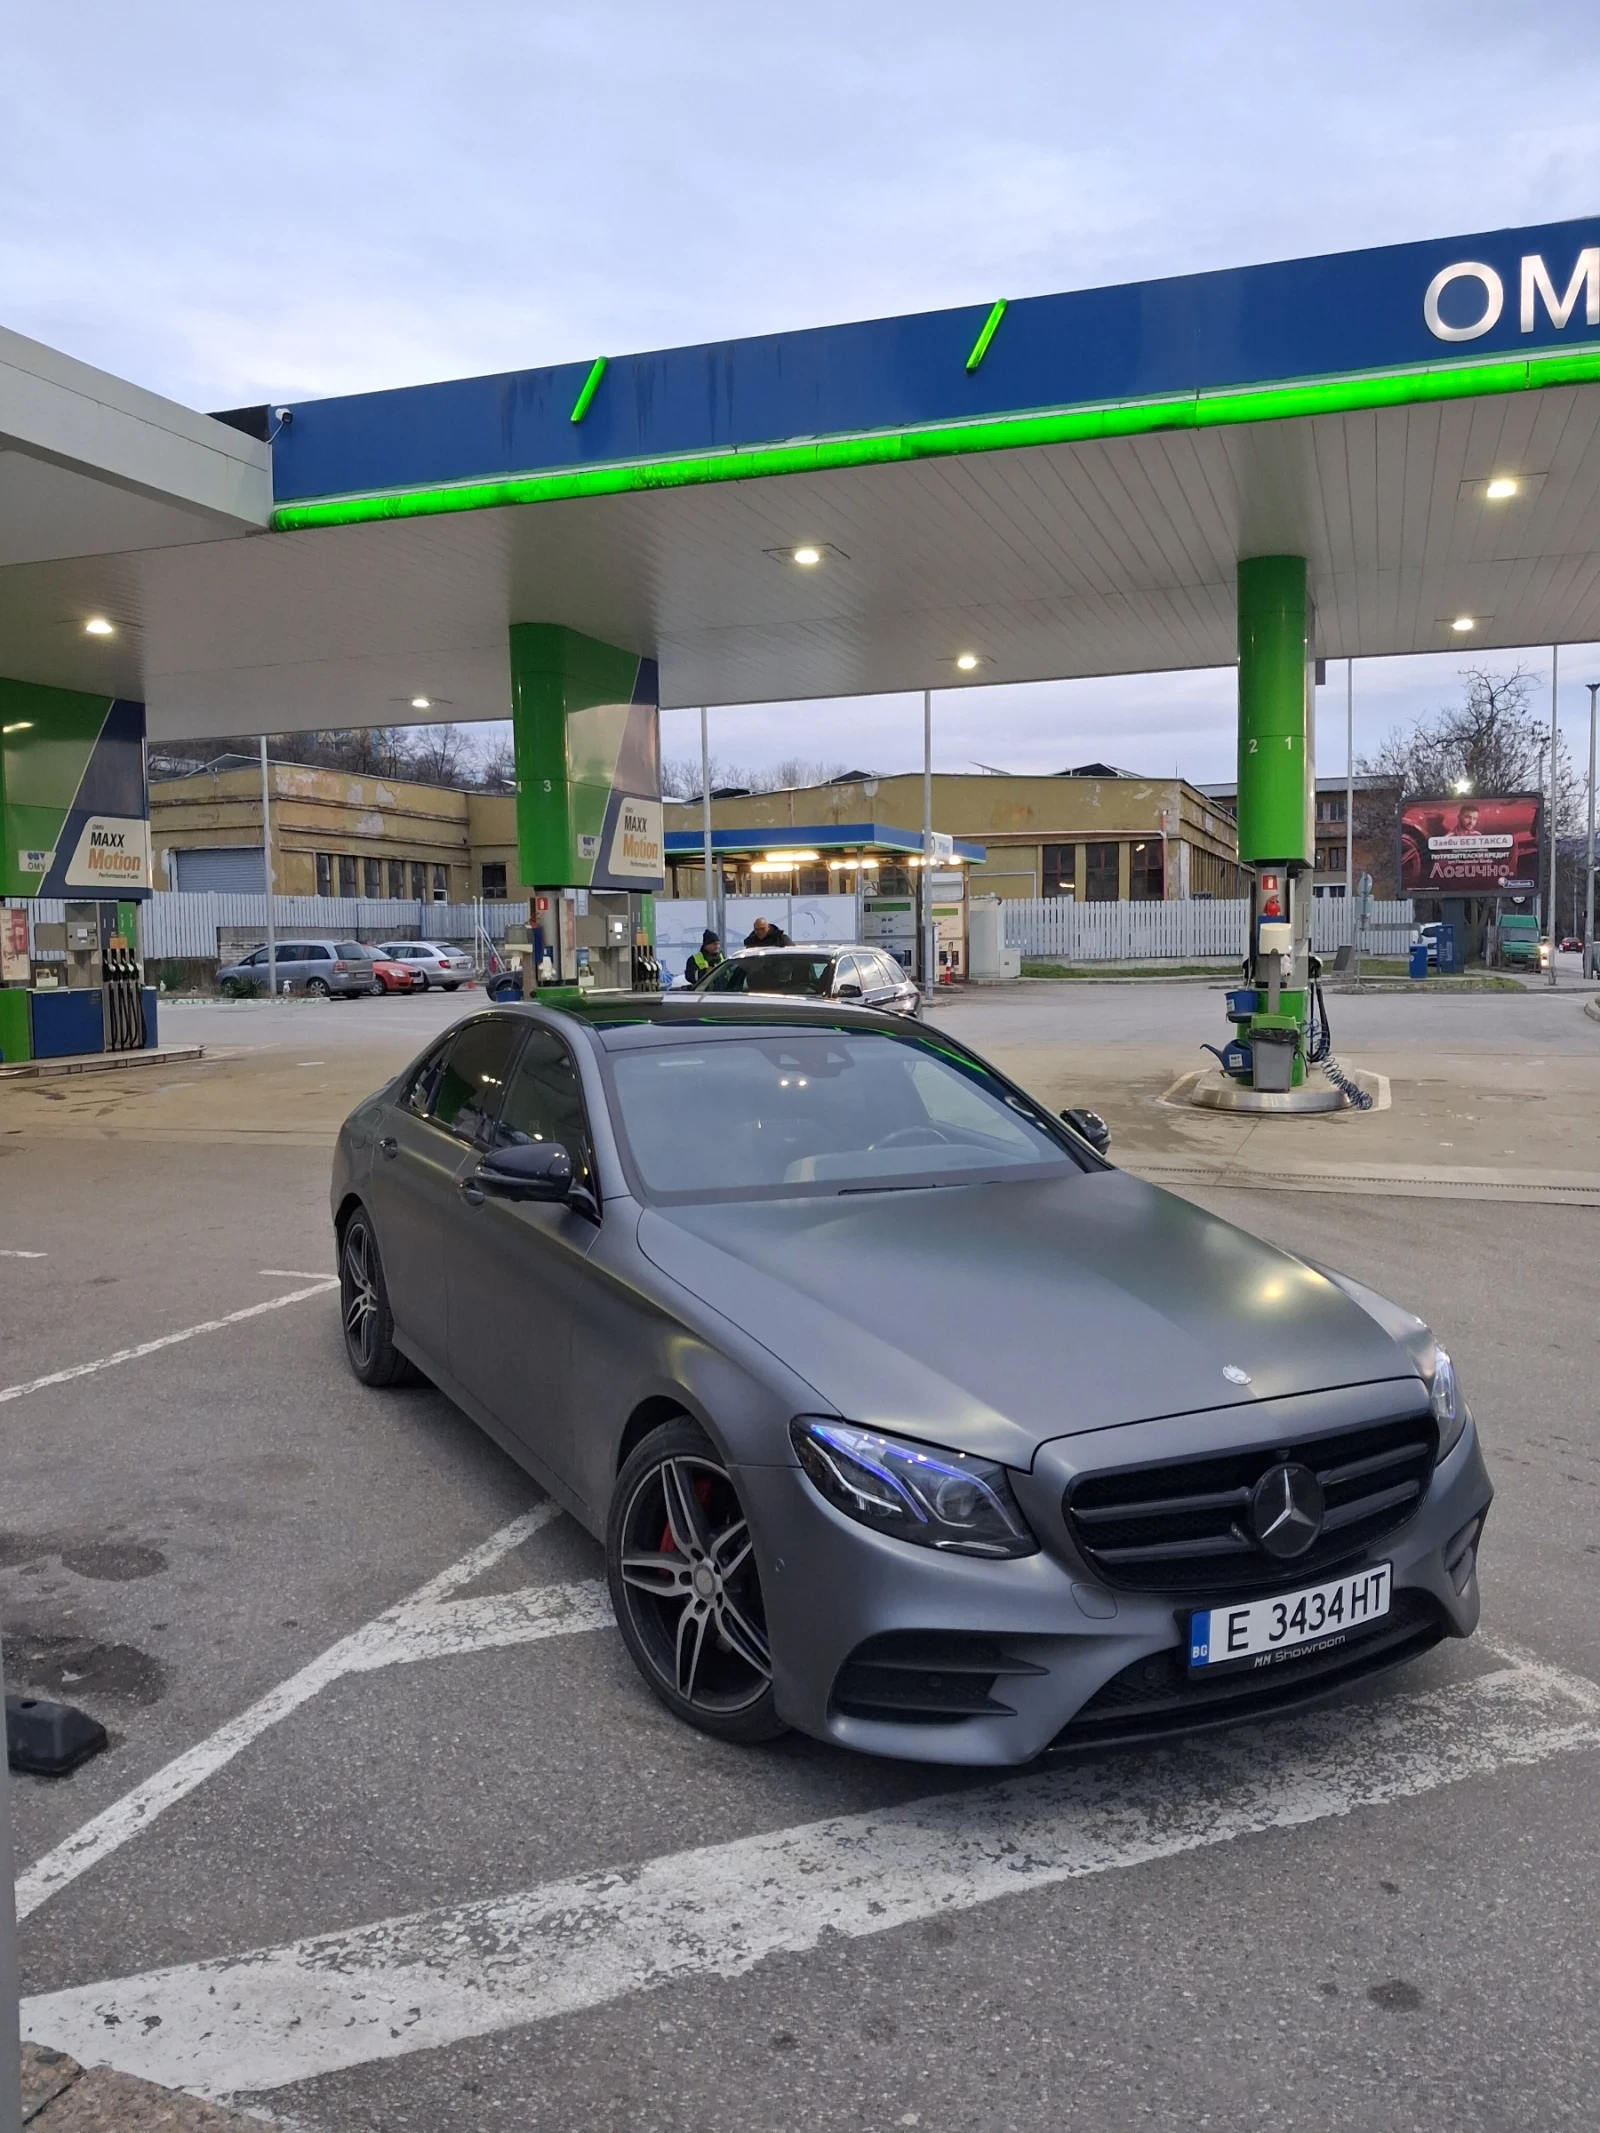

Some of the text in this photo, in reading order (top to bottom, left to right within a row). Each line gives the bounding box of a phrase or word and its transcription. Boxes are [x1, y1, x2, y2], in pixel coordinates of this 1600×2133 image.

[1248, 739, 1258, 754] 2
[1284, 735, 1292, 750] 1
[543, 780, 552, 792] 3
[624, 815, 647, 833] MAXX
[90, 832, 125, 848] MAXX
[623, 833, 658, 859] Motion
[1432, 839, 1458, 847] Заяви
[1480, 837, 1508, 845] ТАКСА
[87, 848, 141, 871] Motion
[1484, 852, 1510, 860] КРЕДИТ
[27, 862, 45, 870] OMV
[1429, 862, 1514, 878] Логично.
[1227, 1571, 1386, 1652] E 3434 HT
[1192, 1644, 1208, 1659] BG
[1253, 1634, 1346, 1668] MM Showroom
